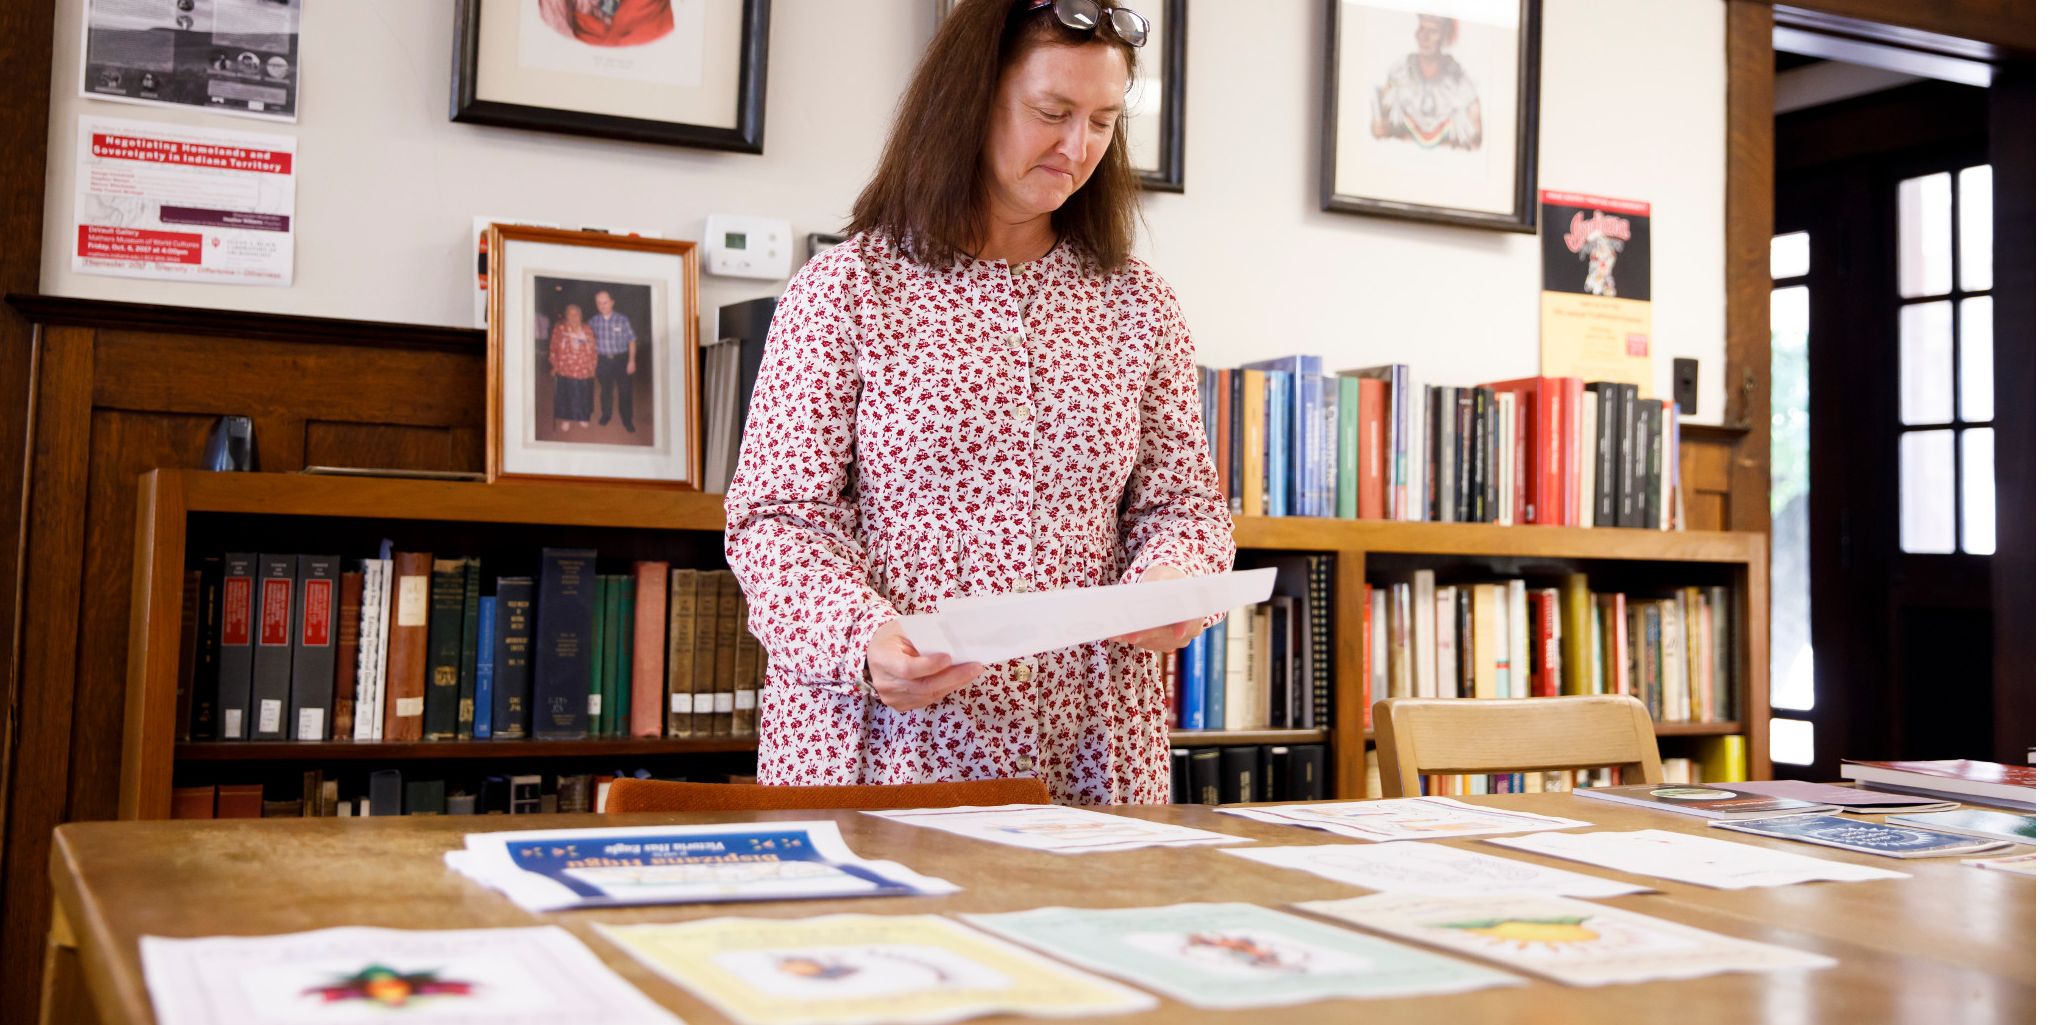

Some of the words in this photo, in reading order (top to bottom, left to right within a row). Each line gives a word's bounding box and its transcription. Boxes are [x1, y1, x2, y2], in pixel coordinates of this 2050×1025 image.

[105, 135, 178, 153] Negotiating
[182, 143, 246, 158] Homelands
[249, 151, 271, 160] and
[93, 144, 166, 162] Sovereignty
[168, 152, 180, 161] in
[183, 154, 227, 166] Indiana
[229, 157, 281, 173] Territory
[116, 235, 145, 245] Museum
[604, 842, 642, 856] Eagle
[643, 842, 670, 853] Has
[672, 841, 726, 852] Victoria
